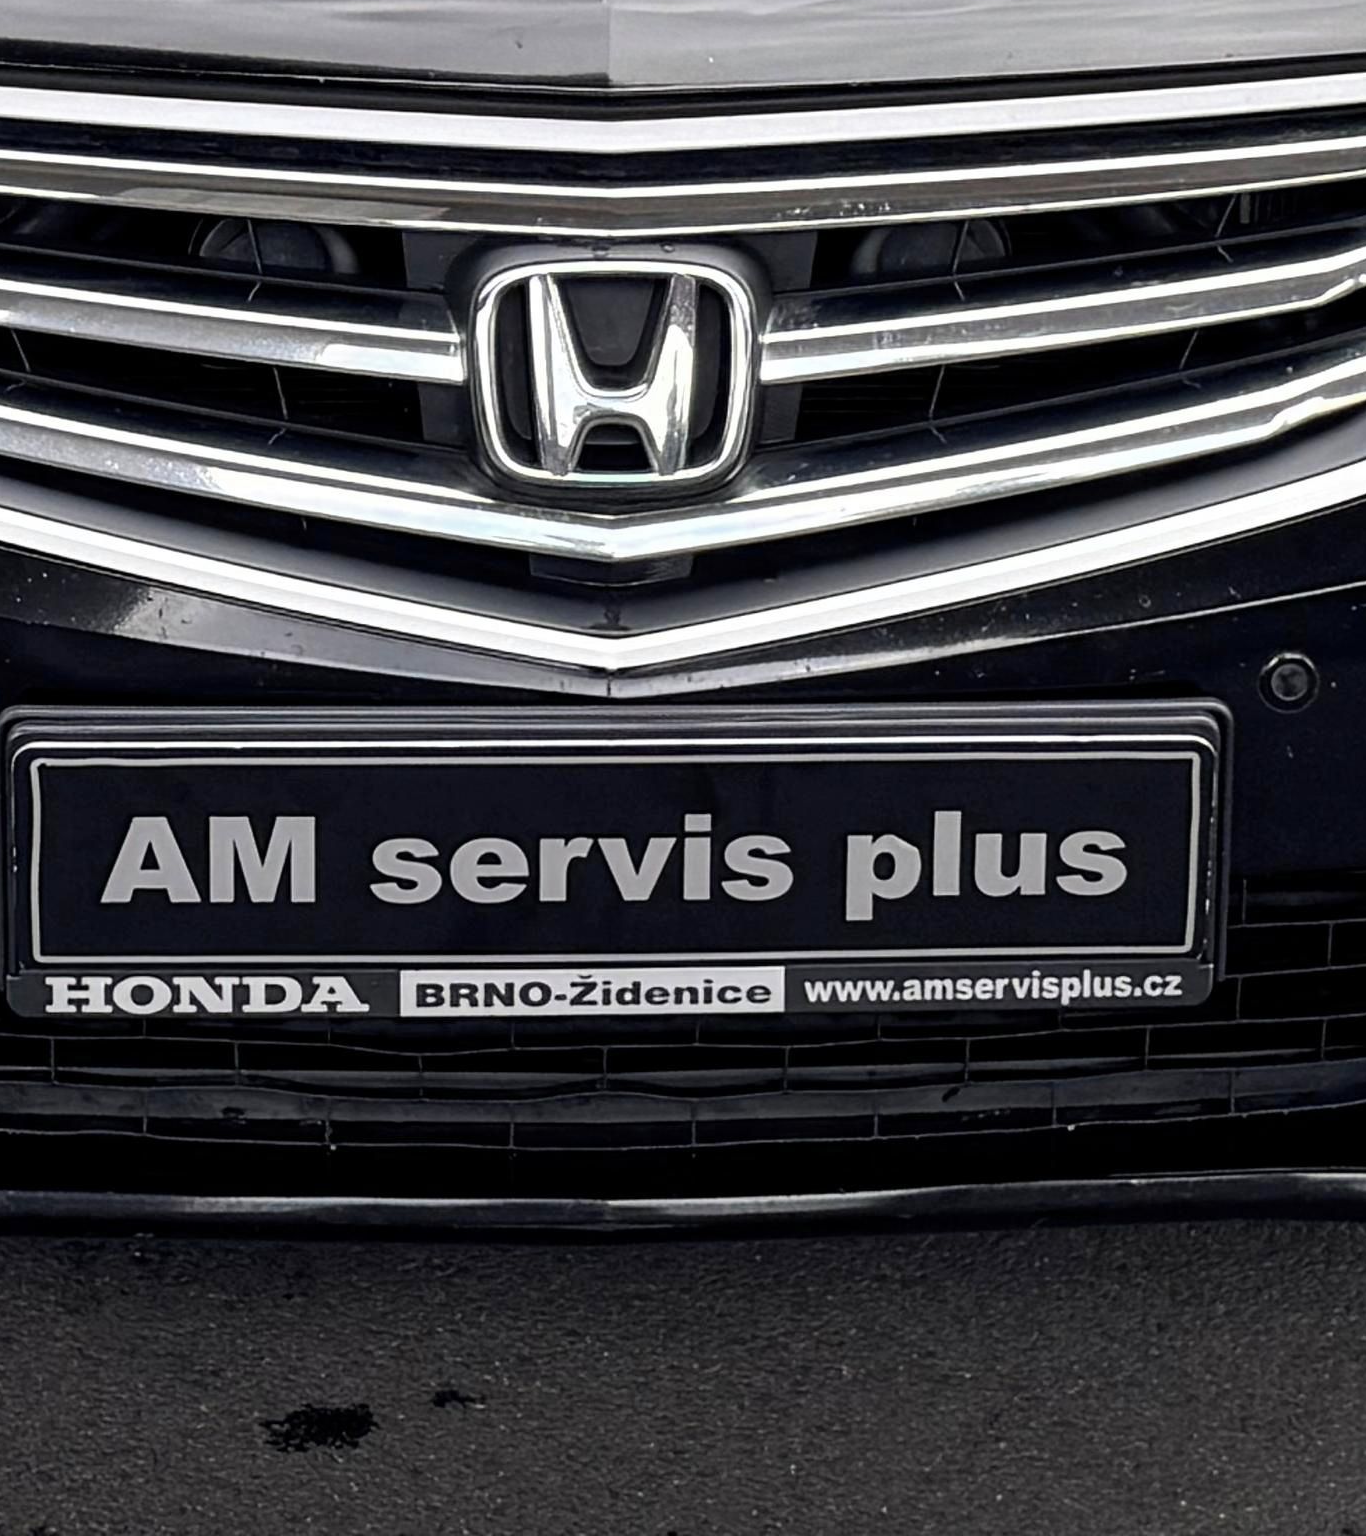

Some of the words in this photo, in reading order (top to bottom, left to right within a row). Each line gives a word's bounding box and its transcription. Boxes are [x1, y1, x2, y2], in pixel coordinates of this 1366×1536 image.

[100, 815, 317, 904] AM
[369, 813, 795, 904] servis
[845, 810, 1128, 922] plus
[43, 975, 371, 1015] HONDA
[414, 974, 773, 1009] BRNO-Židenice
[803, 969, 1184, 1007] www.amservisplus.cz
